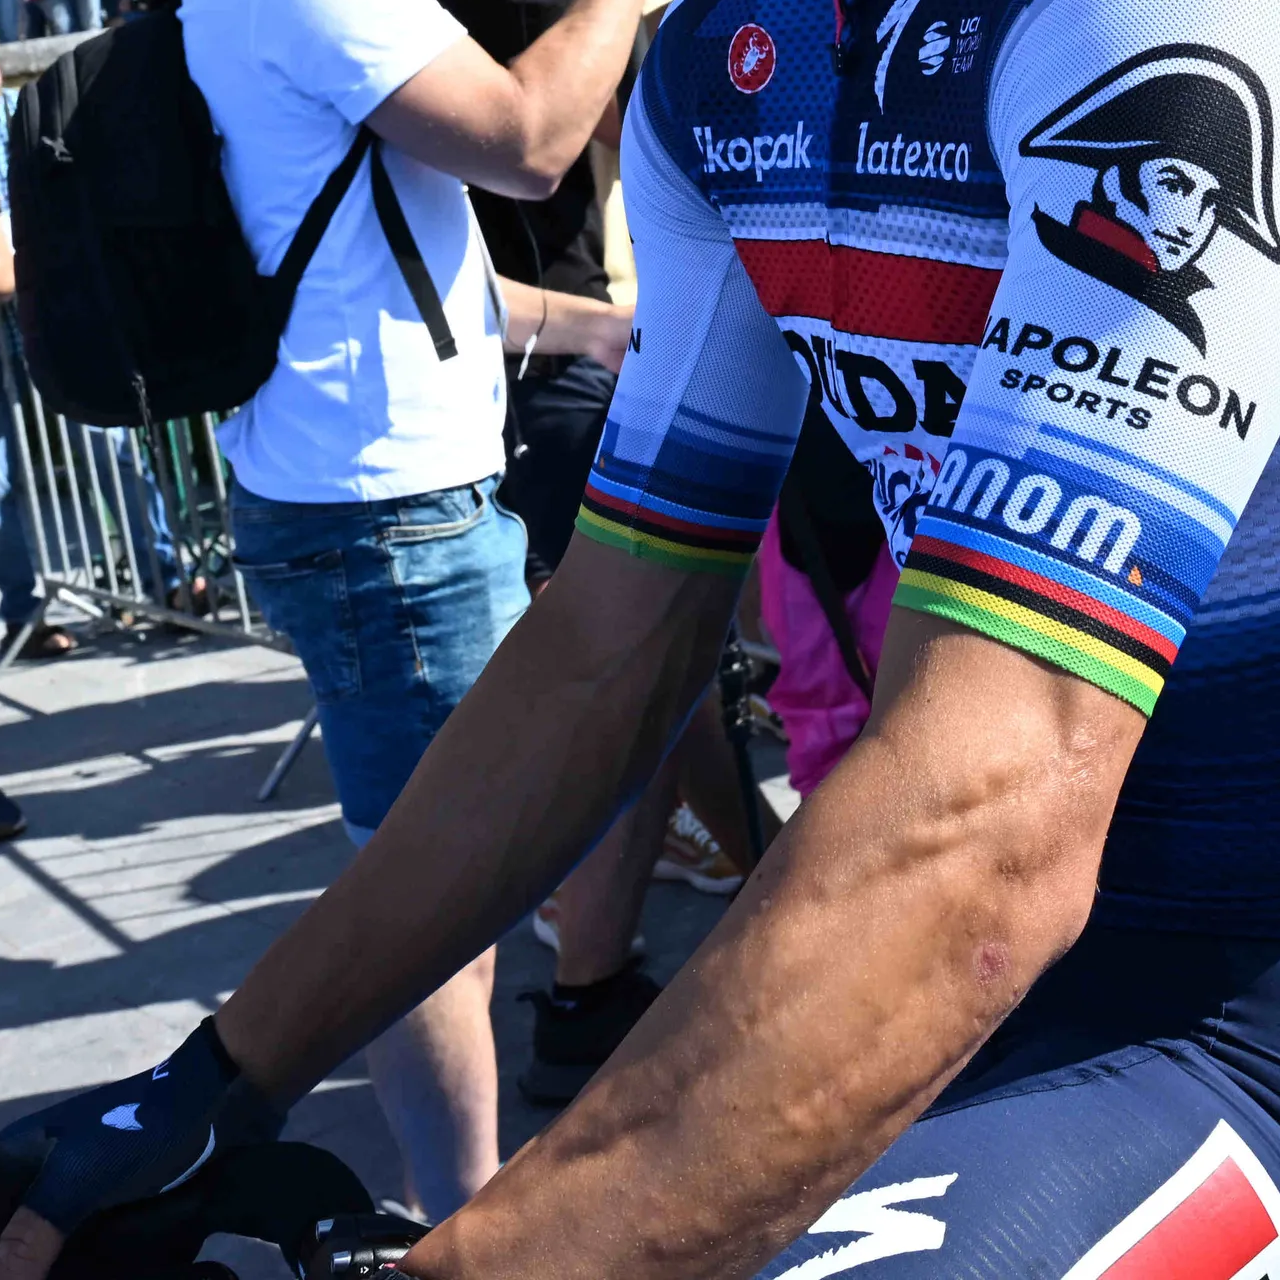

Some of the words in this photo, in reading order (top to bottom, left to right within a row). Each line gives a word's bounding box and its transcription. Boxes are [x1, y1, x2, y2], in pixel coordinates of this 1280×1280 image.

[960, 16, 980, 34] UCI
[951, 54, 974, 73] TEAM
[856, 121, 970, 182] latexco
[1000, 368, 1152, 430] SPORTS
